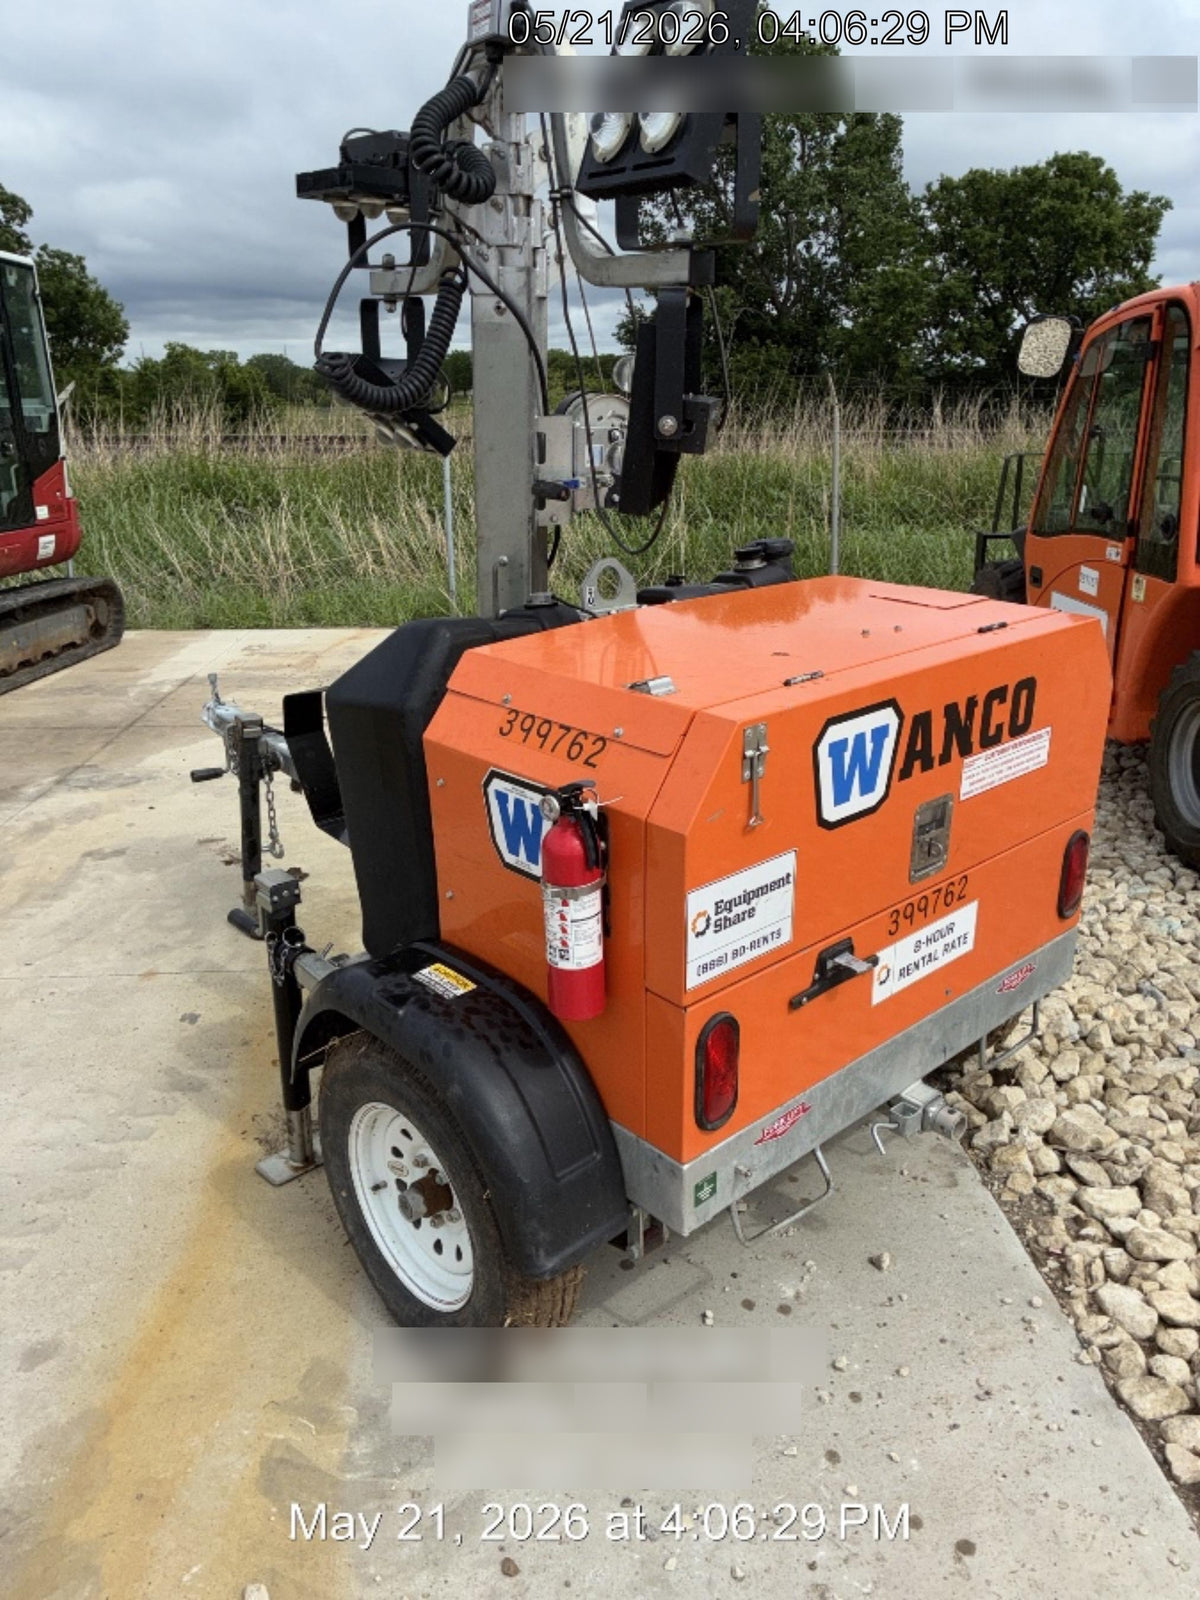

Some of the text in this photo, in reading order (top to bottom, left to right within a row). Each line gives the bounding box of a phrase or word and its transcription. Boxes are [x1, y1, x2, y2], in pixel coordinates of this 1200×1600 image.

[499, 708, 607, 769] 399762
[713, 872, 792, 917] Equipment
[888, 874, 968, 936] 399762
[713, 906, 757, 934] Share
[913, 922, 956, 954] 8-HOUR
[898, 931, 970, 982] RENTAL RATE
